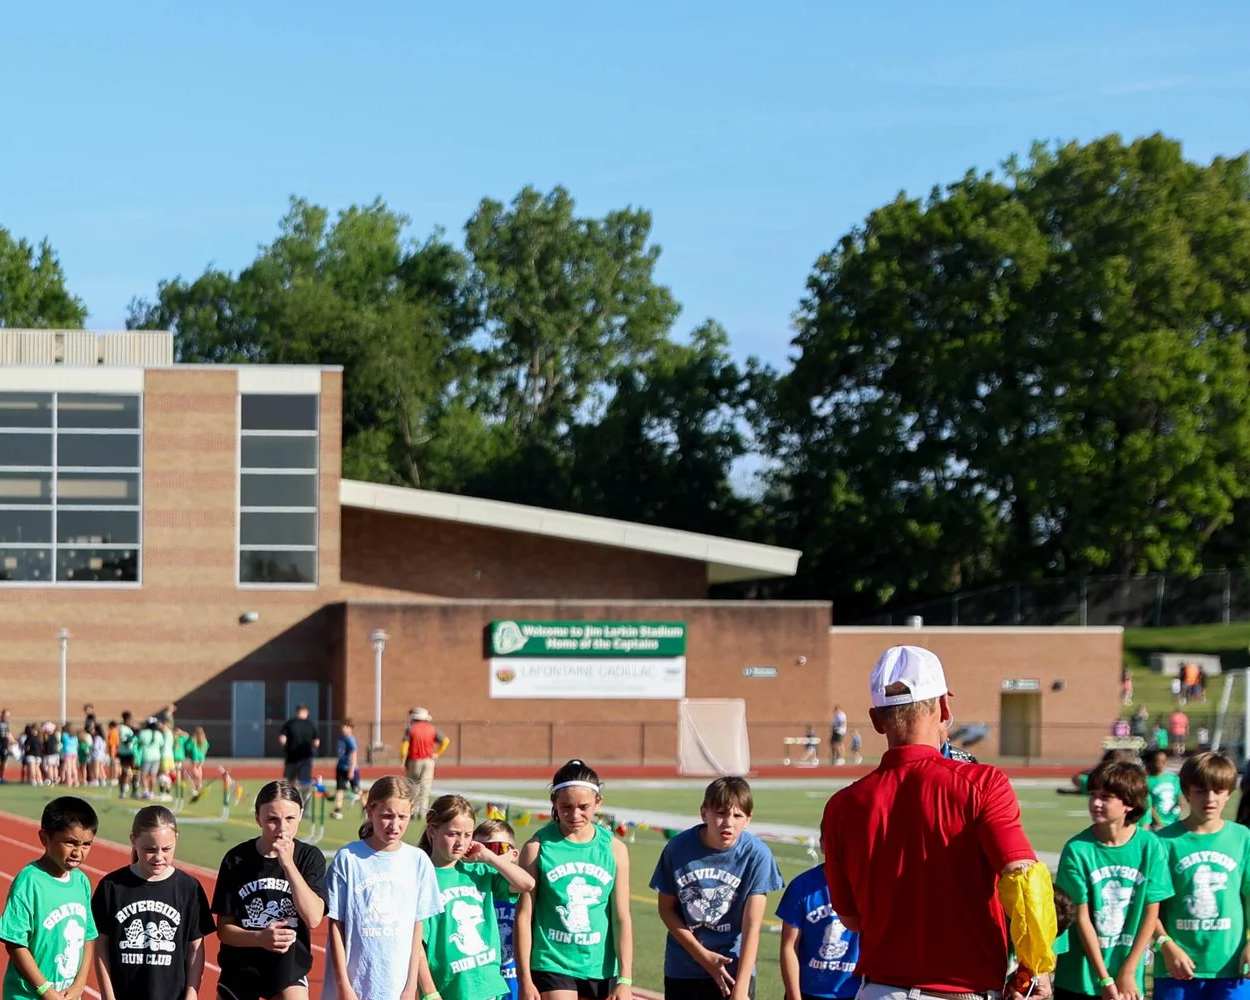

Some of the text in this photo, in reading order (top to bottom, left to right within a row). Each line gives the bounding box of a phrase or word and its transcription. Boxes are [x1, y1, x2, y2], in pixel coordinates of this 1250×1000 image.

[522, 625, 569, 637] Welcome
[570, 626, 583, 637] to
[639, 625, 683, 638] Stadium
[546, 638, 578, 649] Home
[579, 638, 592, 649] of
[612, 638, 659, 651] Captains
[1175, 850, 1237, 874] GRAYSON
[546, 862, 614, 886] GRAYSON
[115, 900, 181, 925] RIVERSIDE
[1176, 917, 1232, 931] RUN CLUB
[548, 928, 601, 945] RUN CLUB
[121, 953, 172, 966] RUN CLUB
[450, 956, 476, 974] RUN
[829, 961, 857, 972] CLUB
